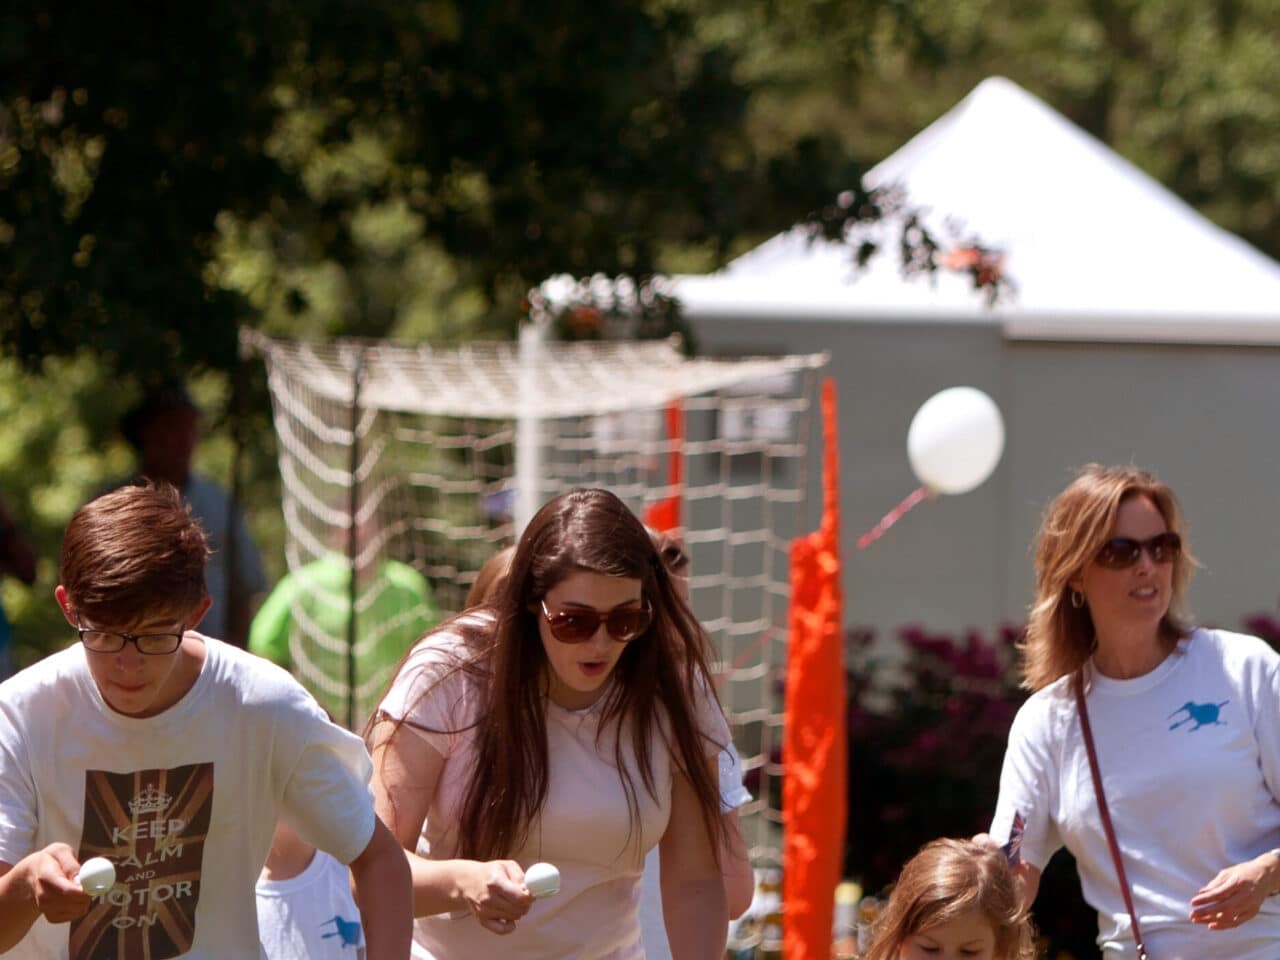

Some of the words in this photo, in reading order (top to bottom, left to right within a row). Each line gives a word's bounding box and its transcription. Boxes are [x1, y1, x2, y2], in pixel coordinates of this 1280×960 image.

[112, 819, 184, 844] KEEP
[125, 870, 156, 882] AND
[112, 912, 158, 929] ON
